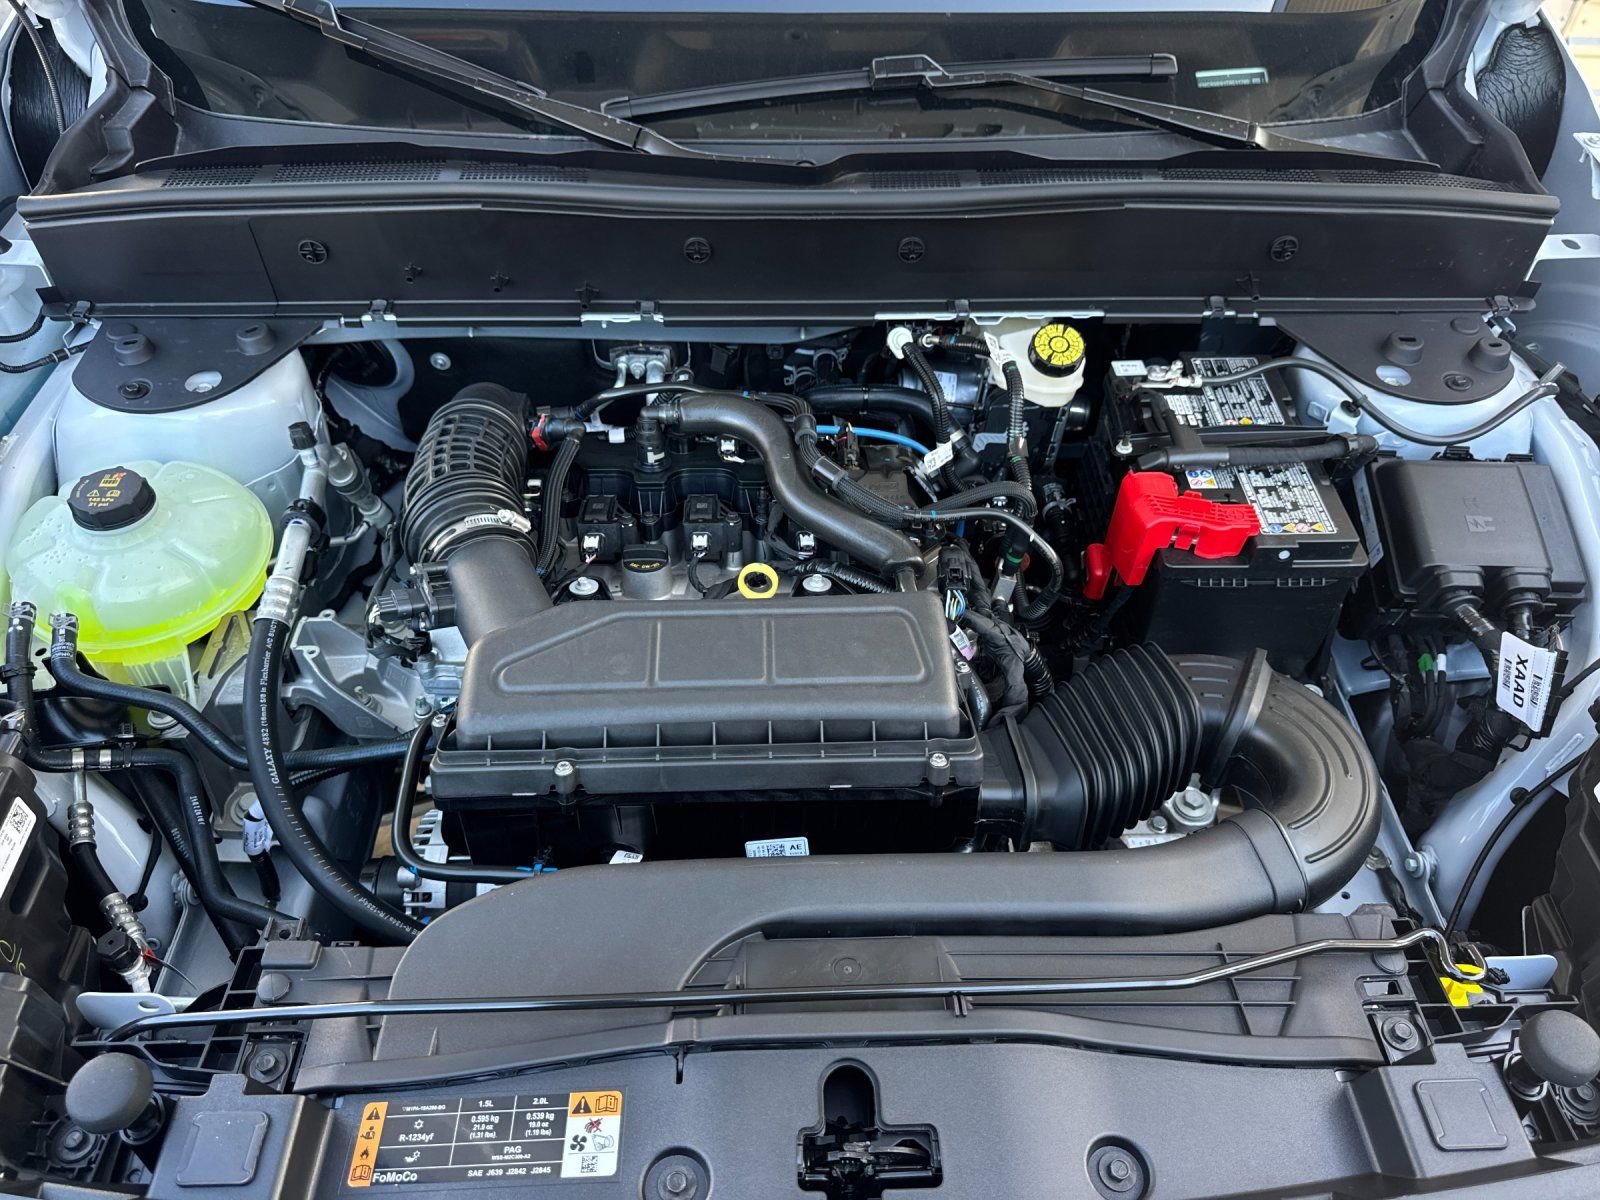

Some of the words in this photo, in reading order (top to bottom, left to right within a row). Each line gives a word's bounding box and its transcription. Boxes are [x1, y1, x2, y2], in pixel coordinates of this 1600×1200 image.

[260, 651, 271, 686] Flexbarrier
[1512, 653, 1528, 708] XAAD
[261, 728, 270, 746] 4882
[264, 748, 280, 784] GALAXY
[789, 843, 802, 851] AE
[532, 1097, 549, 1105] 2.0L
[471, 1115, 489, 1123] 0.595
[490, 1114, 500, 1124] kg
[526, 1112, 544, 1120] 0.539
[545, 1112, 555, 1121] kg
[398, 1132, 435, 1143] R-1234yf
[503, 1145, 522, 1154] PAG
[372, 1171, 418, 1183] FoMoCo
[467, 1169, 484, 1177] SAE
[486, 1168, 503, 1177] J639
[505, 1167, 527, 1175] J2842
